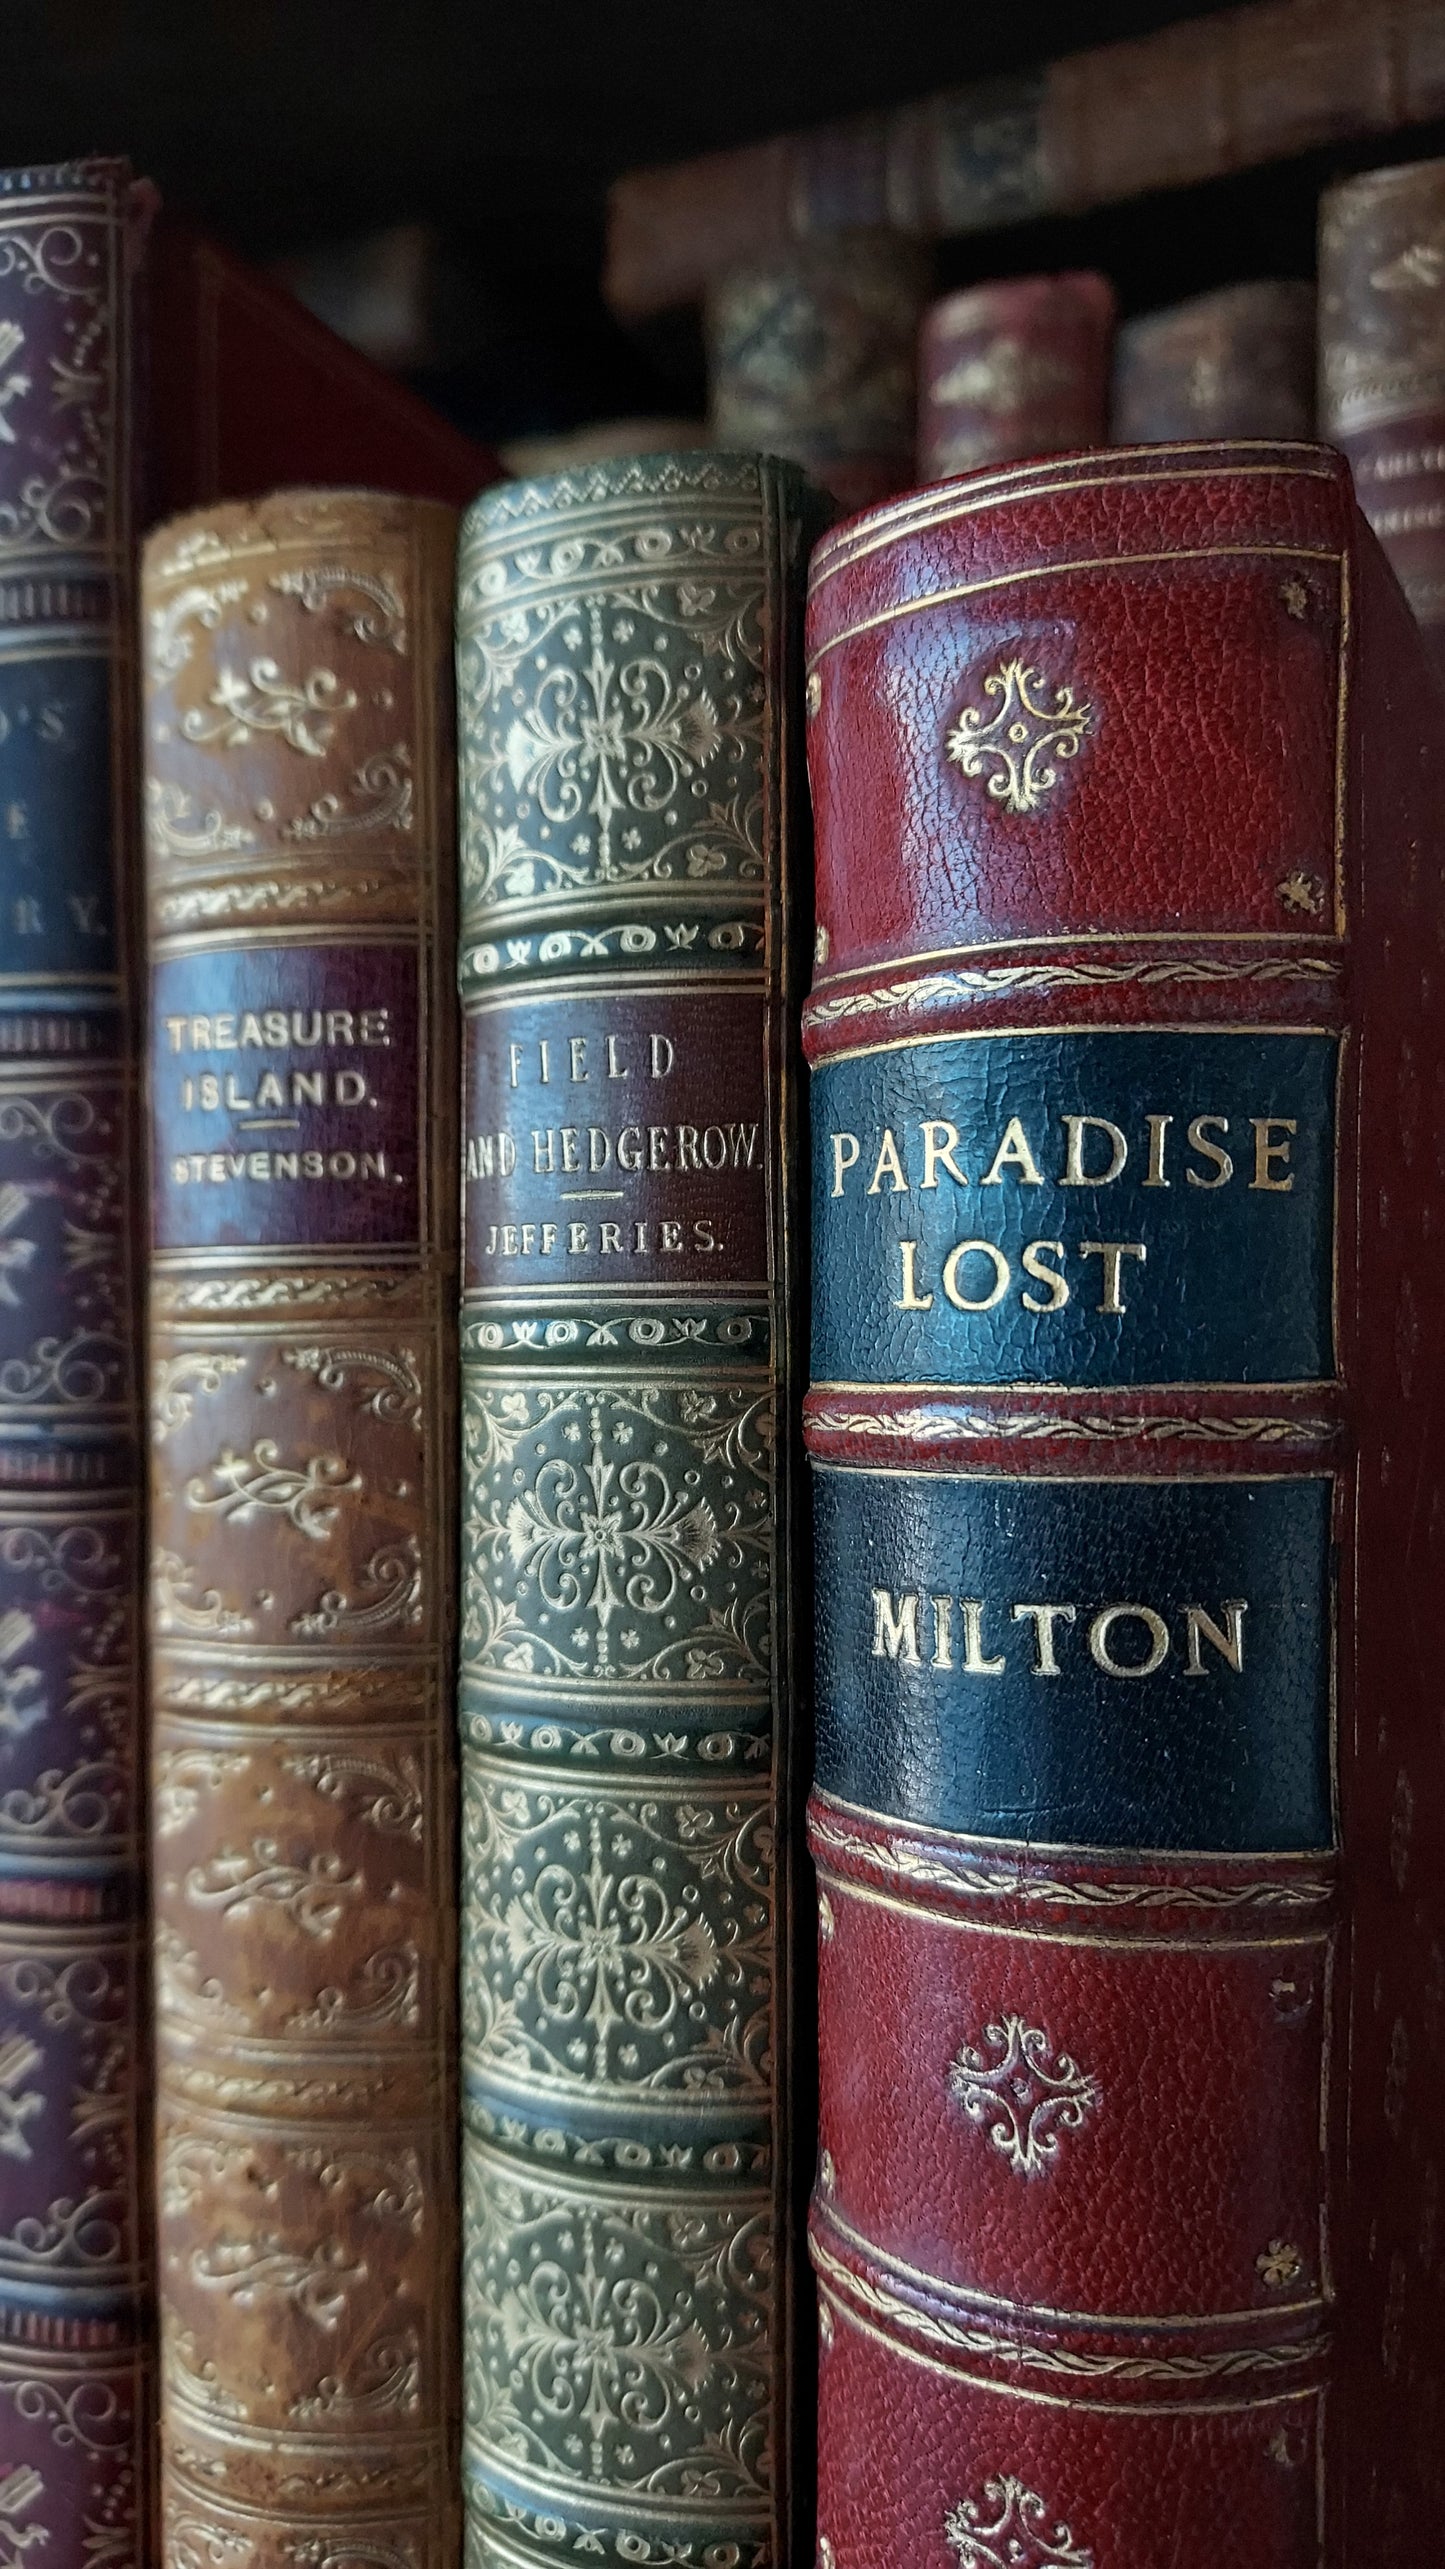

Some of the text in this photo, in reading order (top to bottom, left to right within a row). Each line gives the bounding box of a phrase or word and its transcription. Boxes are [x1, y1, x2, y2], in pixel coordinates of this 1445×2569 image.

[167, 1008, 392, 1053] TREASURE
[508, 1033, 674, 1088] FIELD
[183, 1070, 378, 1112] ISLAND.
[173, 1150, 403, 1184] STEVENSON.
[465, 1122, 764, 1181] AND HEDGEROW.
[829, 1114, 1298, 1198] PARADISE
[485, 1219, 725, 1256] JEFFERIES.
[892, 1239, 1148, 1315] LOST
[870, 1587, 1249, 1678] MILTON
